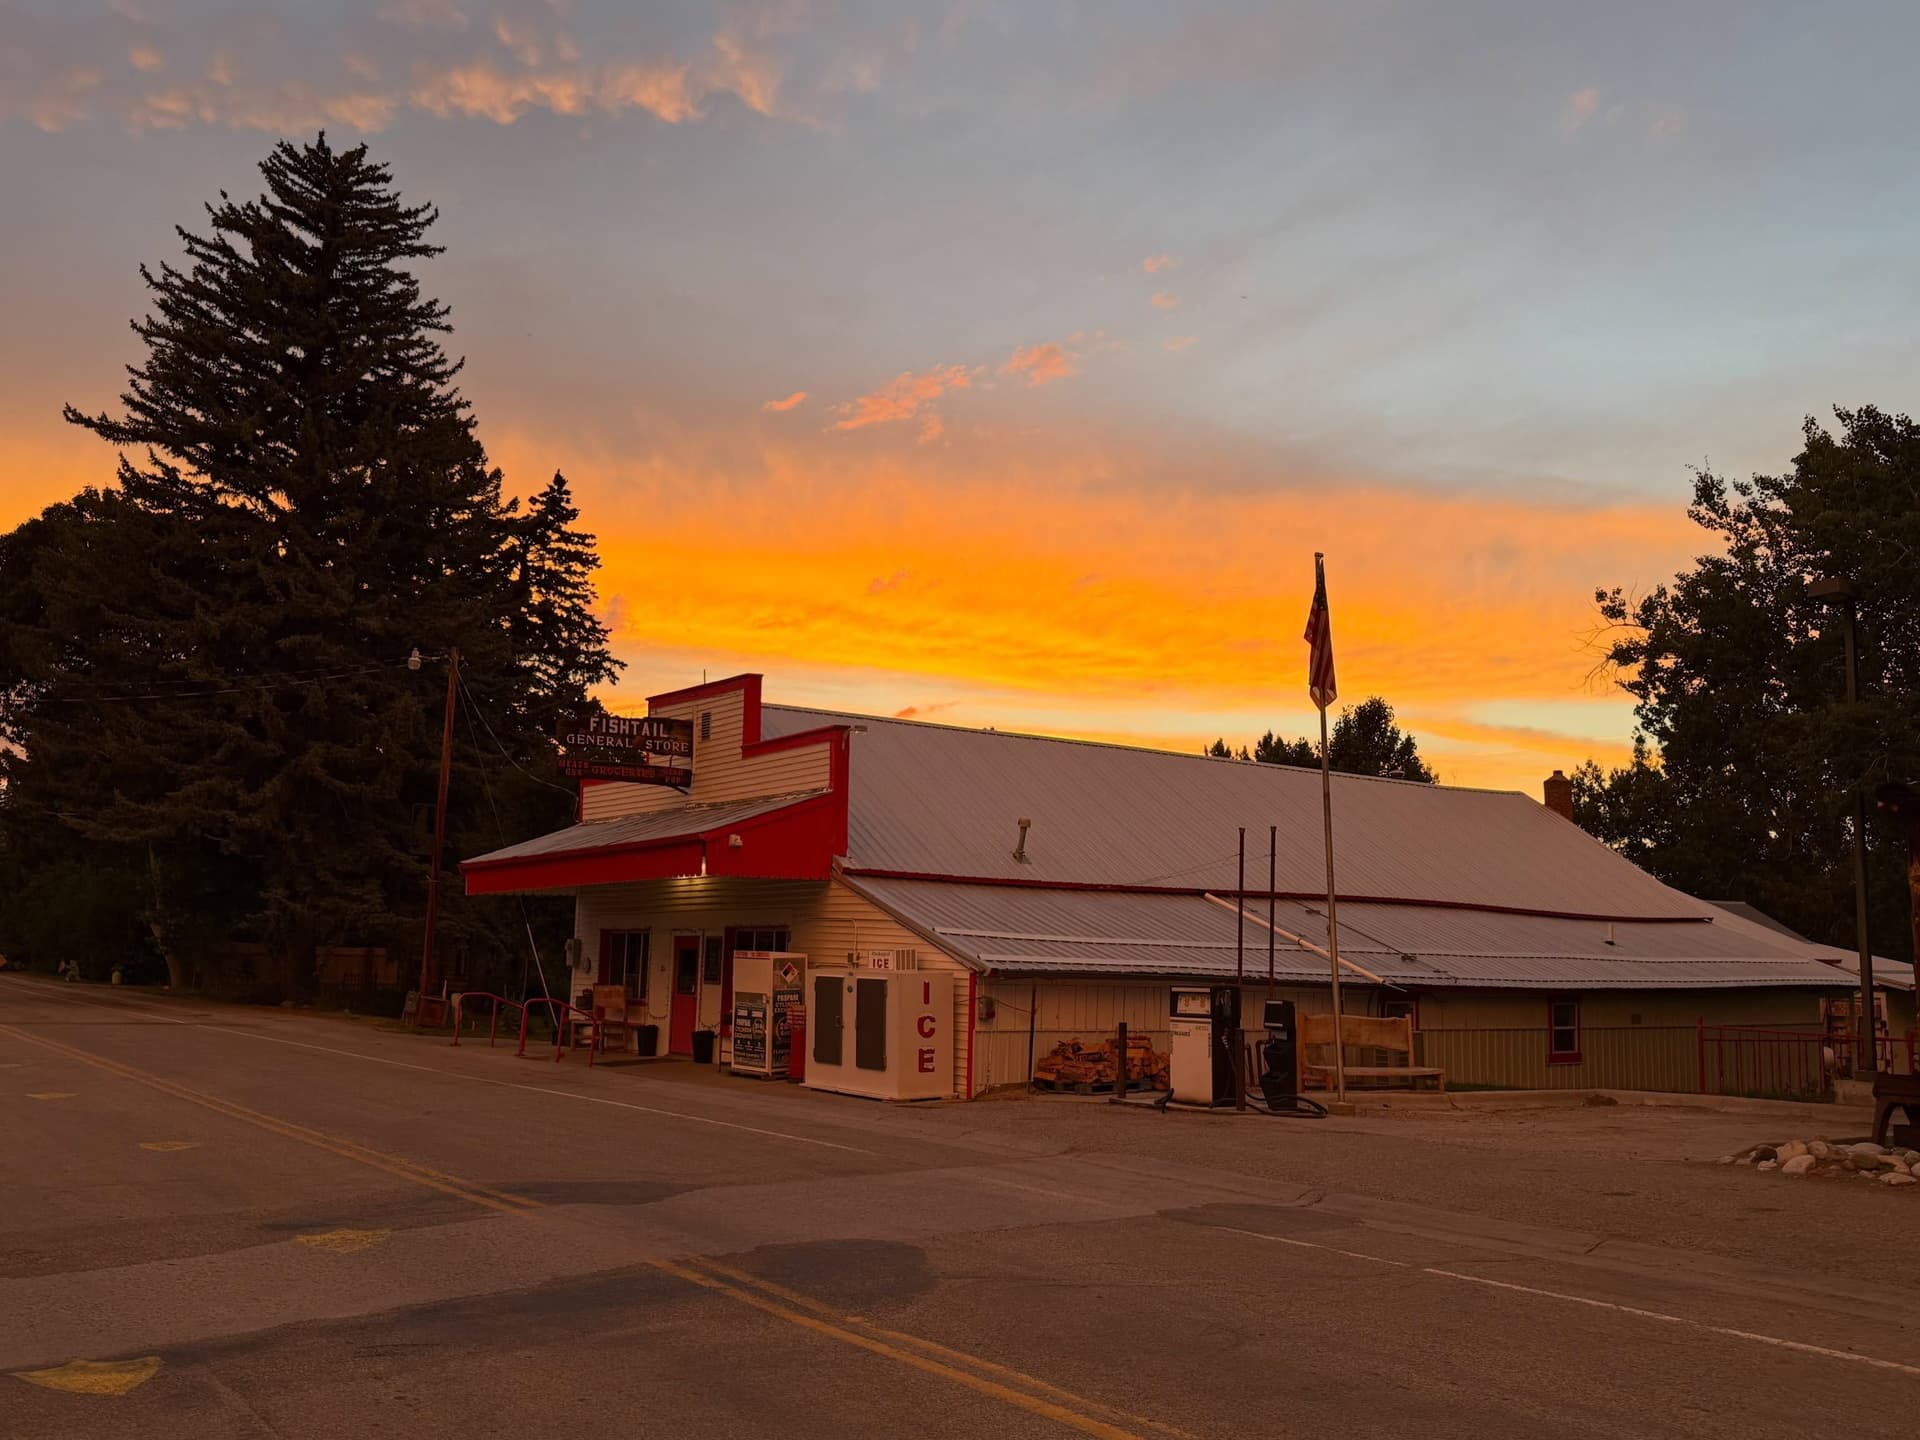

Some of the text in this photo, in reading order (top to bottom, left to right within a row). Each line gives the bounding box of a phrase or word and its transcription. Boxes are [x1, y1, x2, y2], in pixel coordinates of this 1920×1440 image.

[589, 716, 669, 738] FISHTAIL
[566, 733, 689, 753] GENERAL STORE
[591, 766, 656, 778] GROCERIES
[872, 958, 889, 969] ICE
[916, 980, 937, 1074] ICE
